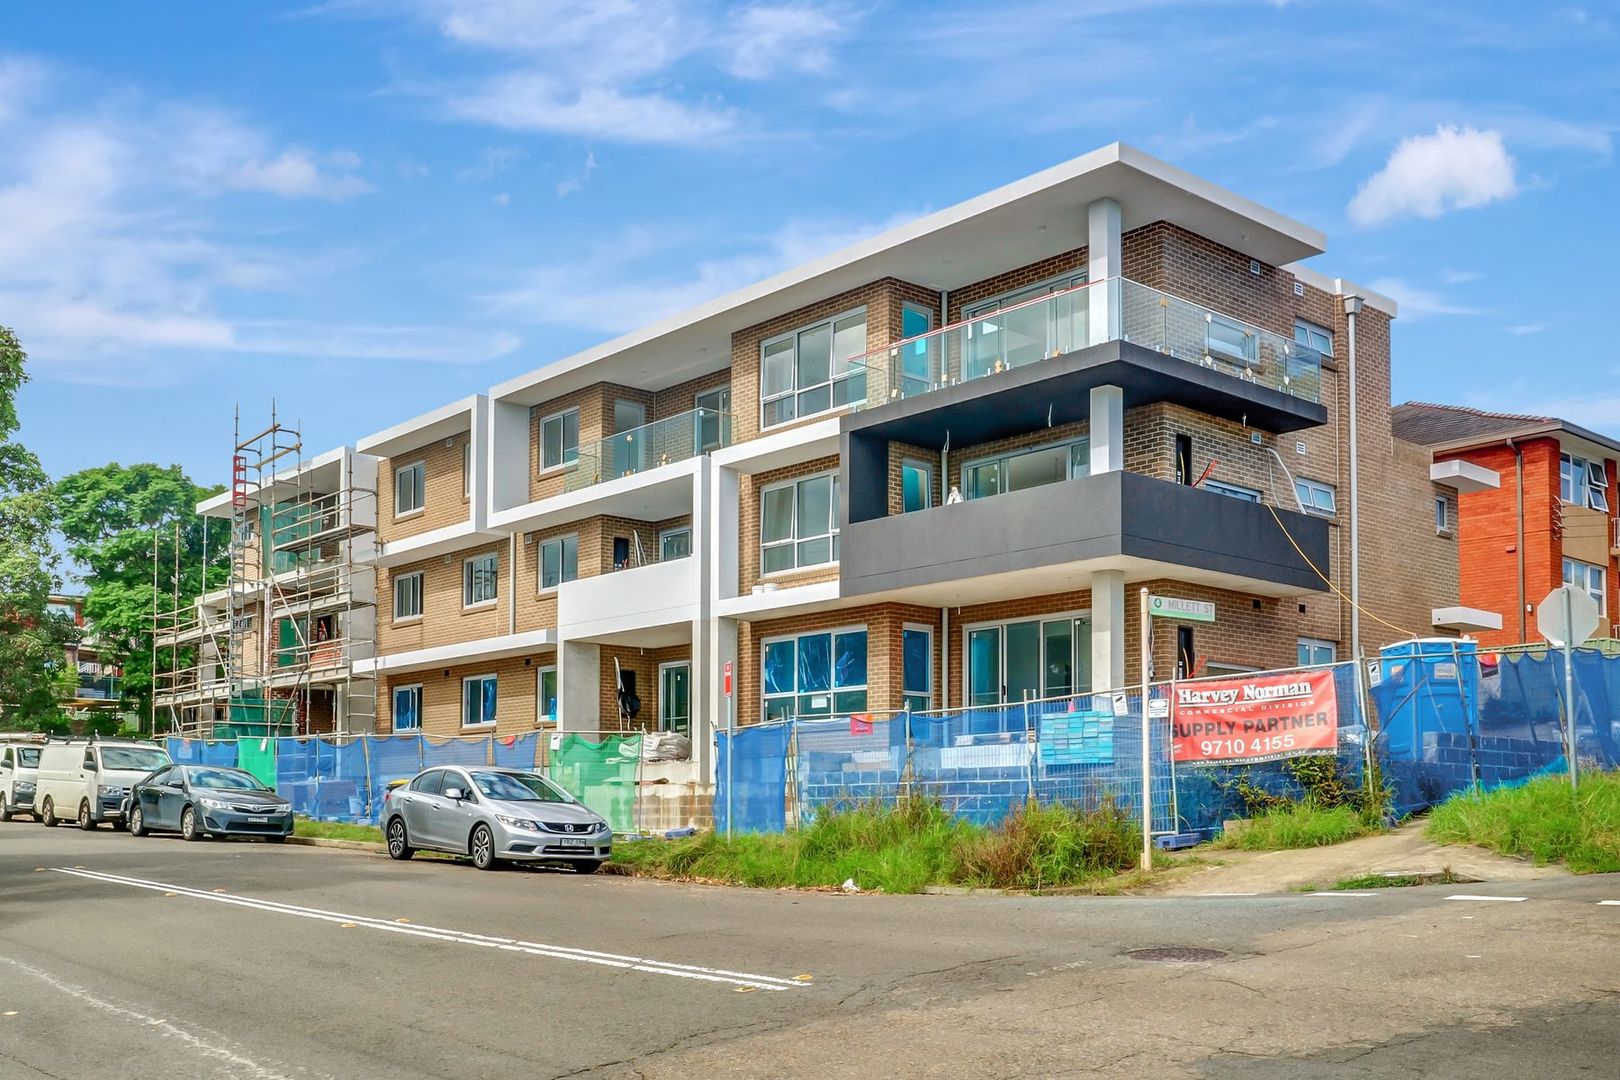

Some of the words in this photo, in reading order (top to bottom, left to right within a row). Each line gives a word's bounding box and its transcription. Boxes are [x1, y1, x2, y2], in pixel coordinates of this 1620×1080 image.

[1168, 600, 1200, 612] MILLETT
[1203, 604, 1214, 614] ST
[1177, 688, 1240, 706] Harvey
[1242, 681, 1313, 701] Norman
[1179, 706, 1255, 716] COMMERCIAL
[1261, 700, 1315, 710] DIVISION
[1168, 720, 1236, 739] SUPPLY
[1243, 712, 1329, 734] PARTNER
[1201, 738, 1246, 756] 9710
[1250, 734, 1295, 753] 4155
